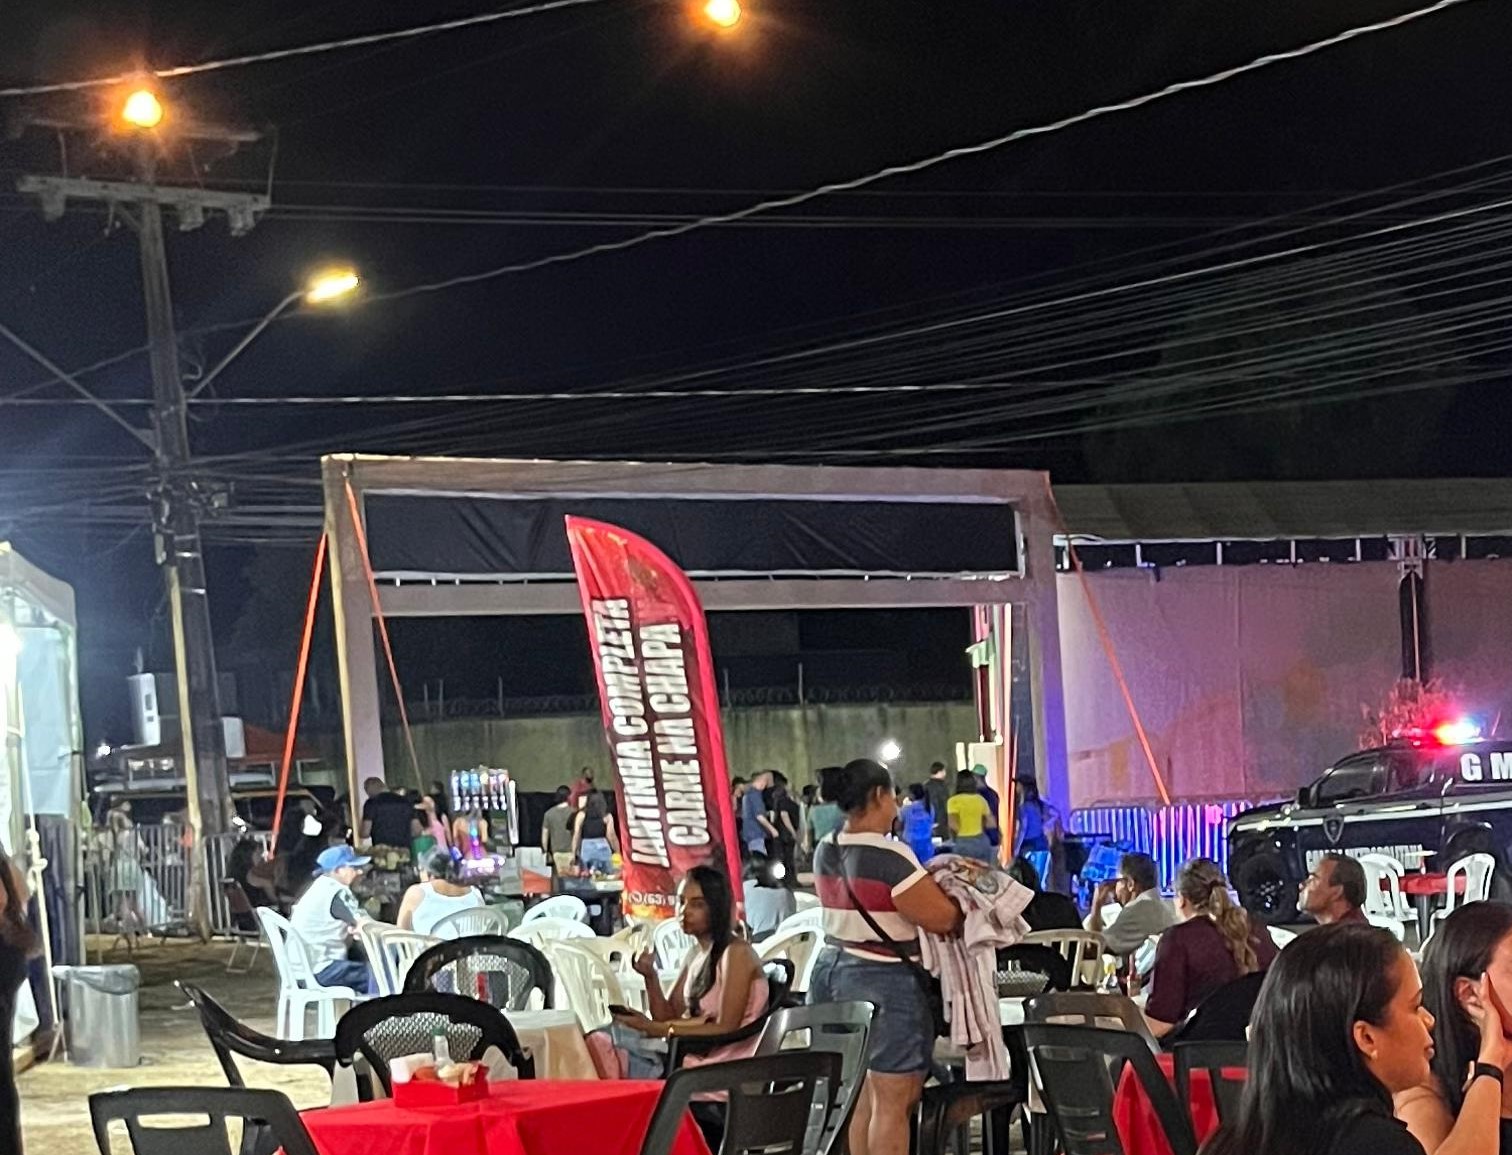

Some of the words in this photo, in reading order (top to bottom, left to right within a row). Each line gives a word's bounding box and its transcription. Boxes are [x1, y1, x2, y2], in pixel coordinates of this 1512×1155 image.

[592, 598, 650, 736] COMPLETA
[639, 623, 692, 714] CHAPA
[653, 716, 698, 755] NA
[615, 740, 670, 868] JANTINHA
[659, 759, 711, 846] CARNE
